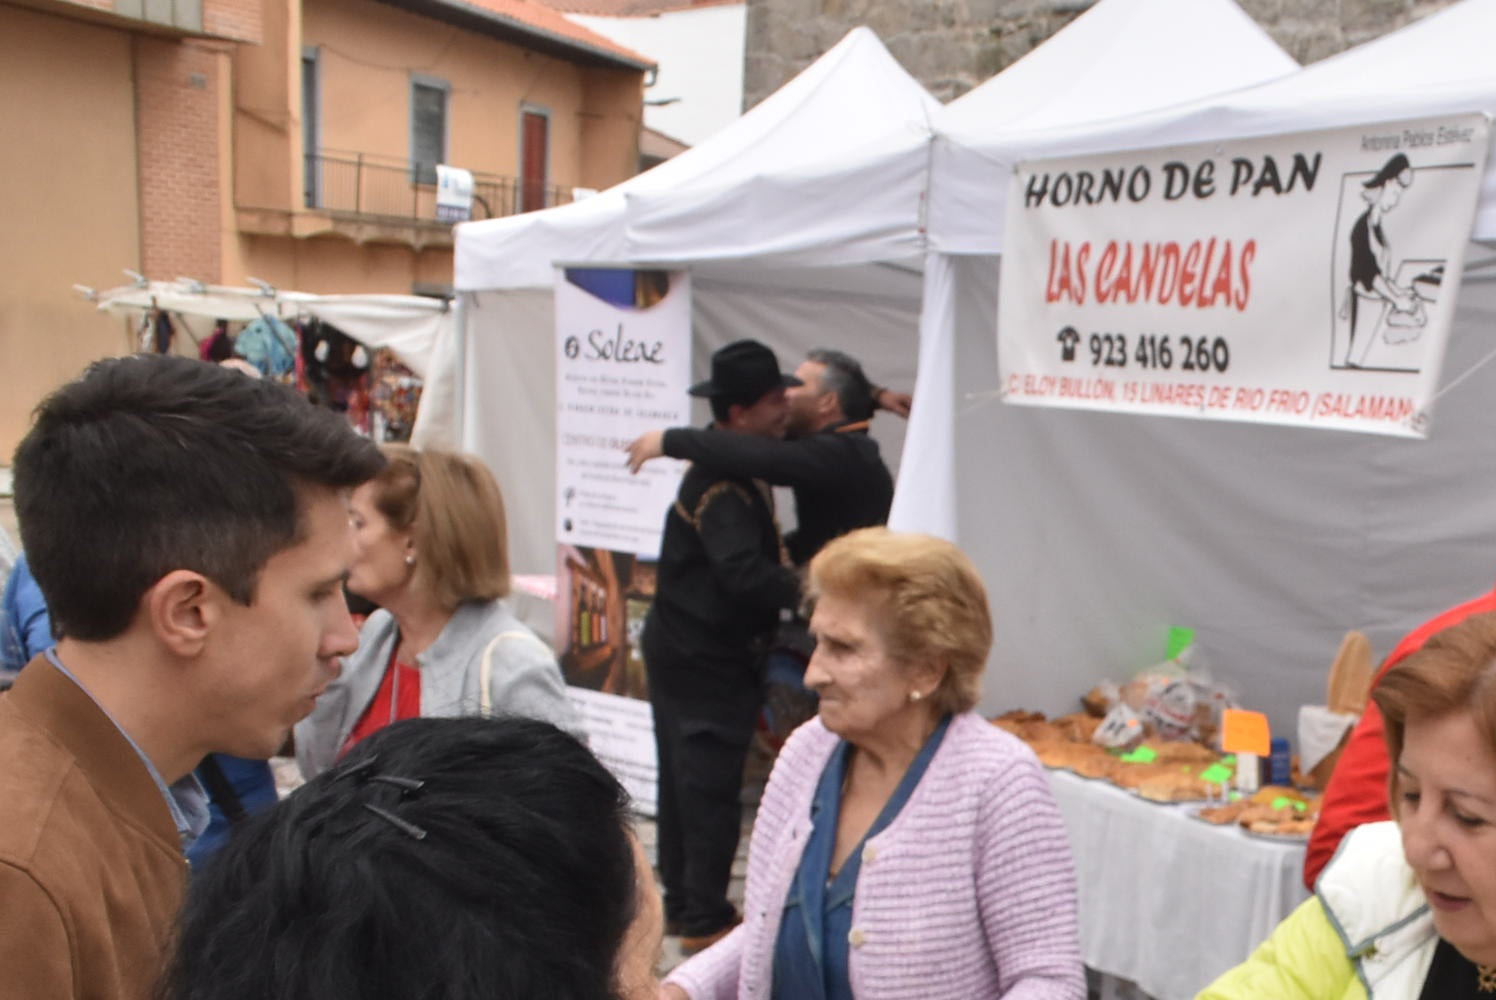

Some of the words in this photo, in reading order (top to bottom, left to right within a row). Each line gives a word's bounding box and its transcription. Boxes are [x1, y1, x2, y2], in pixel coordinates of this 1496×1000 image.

[1024, 164, 1150, 208] HORNO
[1163, 160, 1216, 200] DE
[1229, 153, 1322, 197] PAN
[1046, 239, 1091, 306] LAS
[1093, 237, 1257, 312] CANDELAS
[1090, 334, 1127, 368] 923
[1135, 335, 1173, 370] 416
[1181, 336, 1229, 372] 260
[1024, 374, 1057, 395] ELOY
[1123, 377, 1138, 402] 15
[1141, 378, 1204, 406] LINARES
[1208, 385, 1232, 408] DE
[1233, 387, 1264, 411] RIO
[1266, 389, 1311, 414] FRIO
